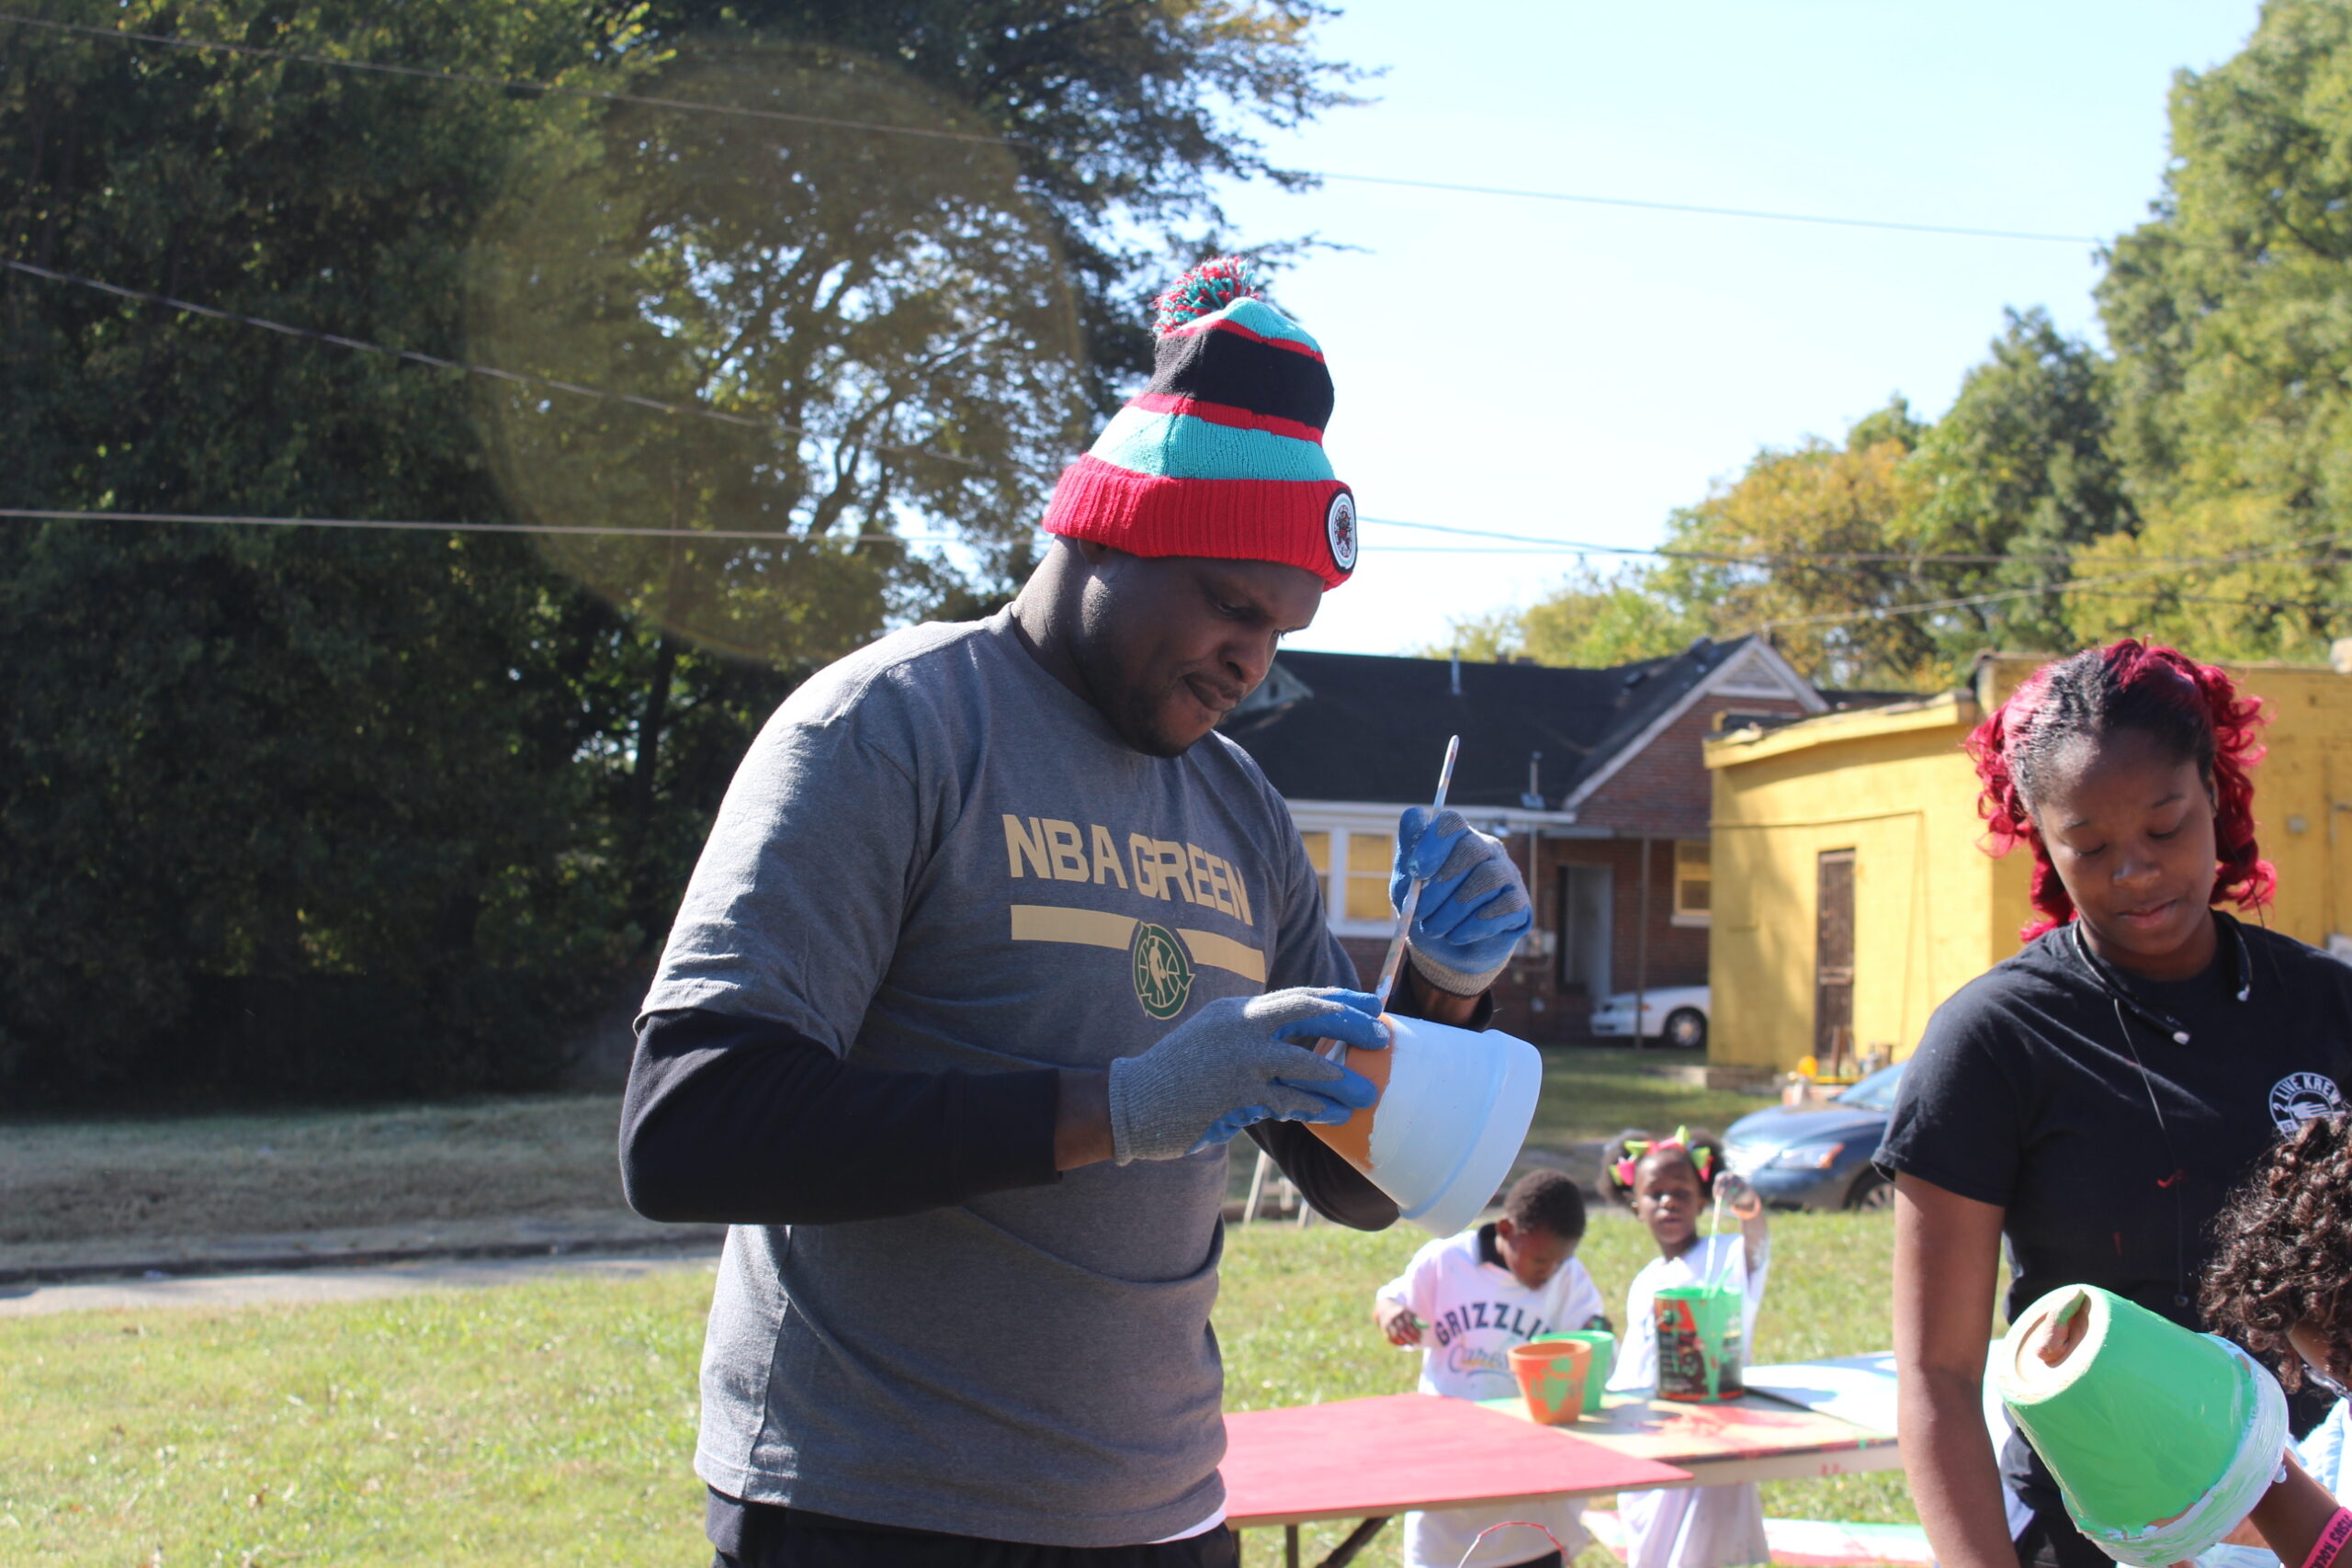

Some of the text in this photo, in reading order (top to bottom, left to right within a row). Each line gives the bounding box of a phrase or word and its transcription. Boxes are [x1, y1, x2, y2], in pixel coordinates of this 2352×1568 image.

[1001, 813, 1253, 927] NBA GREEN
[2272, 1074, 2342, 1113] 2 LIVE KREW
